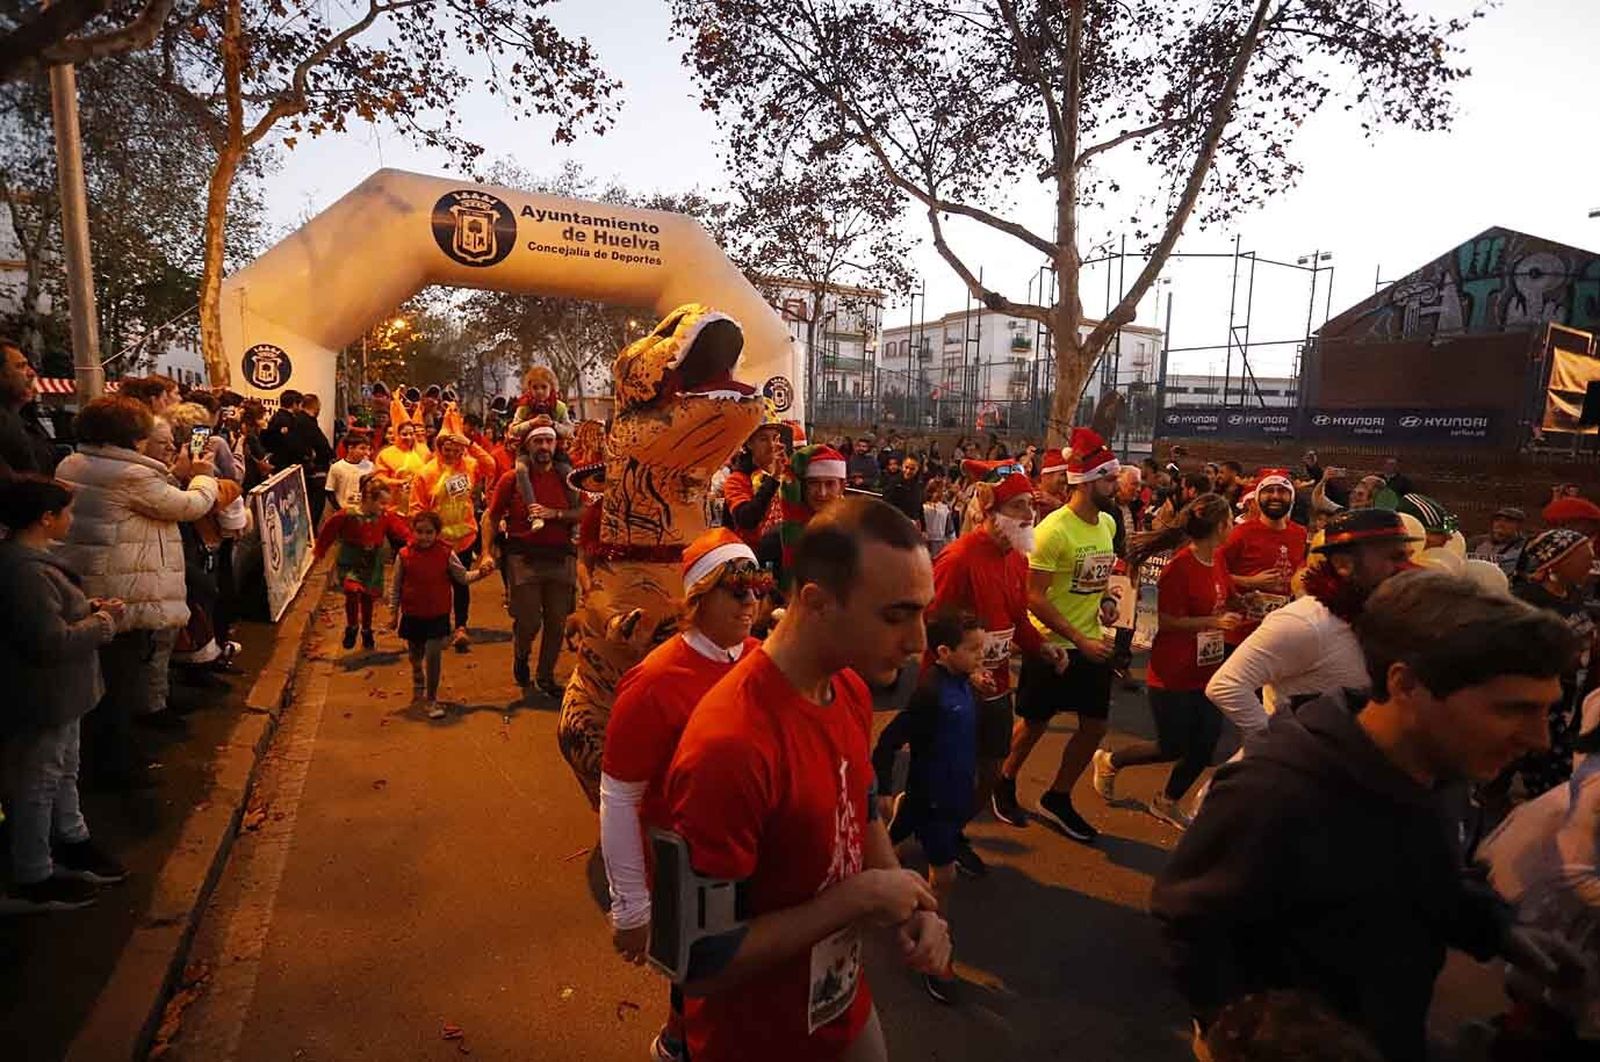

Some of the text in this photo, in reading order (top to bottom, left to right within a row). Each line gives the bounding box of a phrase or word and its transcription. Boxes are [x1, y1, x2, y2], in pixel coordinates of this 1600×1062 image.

[520, 205, 659, 234] Ayuntamiento
[562, 226, 660, 251] de Huelva
[594, 249, 607, 259] de
[611, 251, 662, 265] Deportes
[1182, 415, 1218, 424] HYUNDAI
[1246, 415, 1289, 424] HYUNDAI
[1332, 417, 1385, 426] HYUNDAI
[1424, 417, 1488, 427] HYUNDAI
